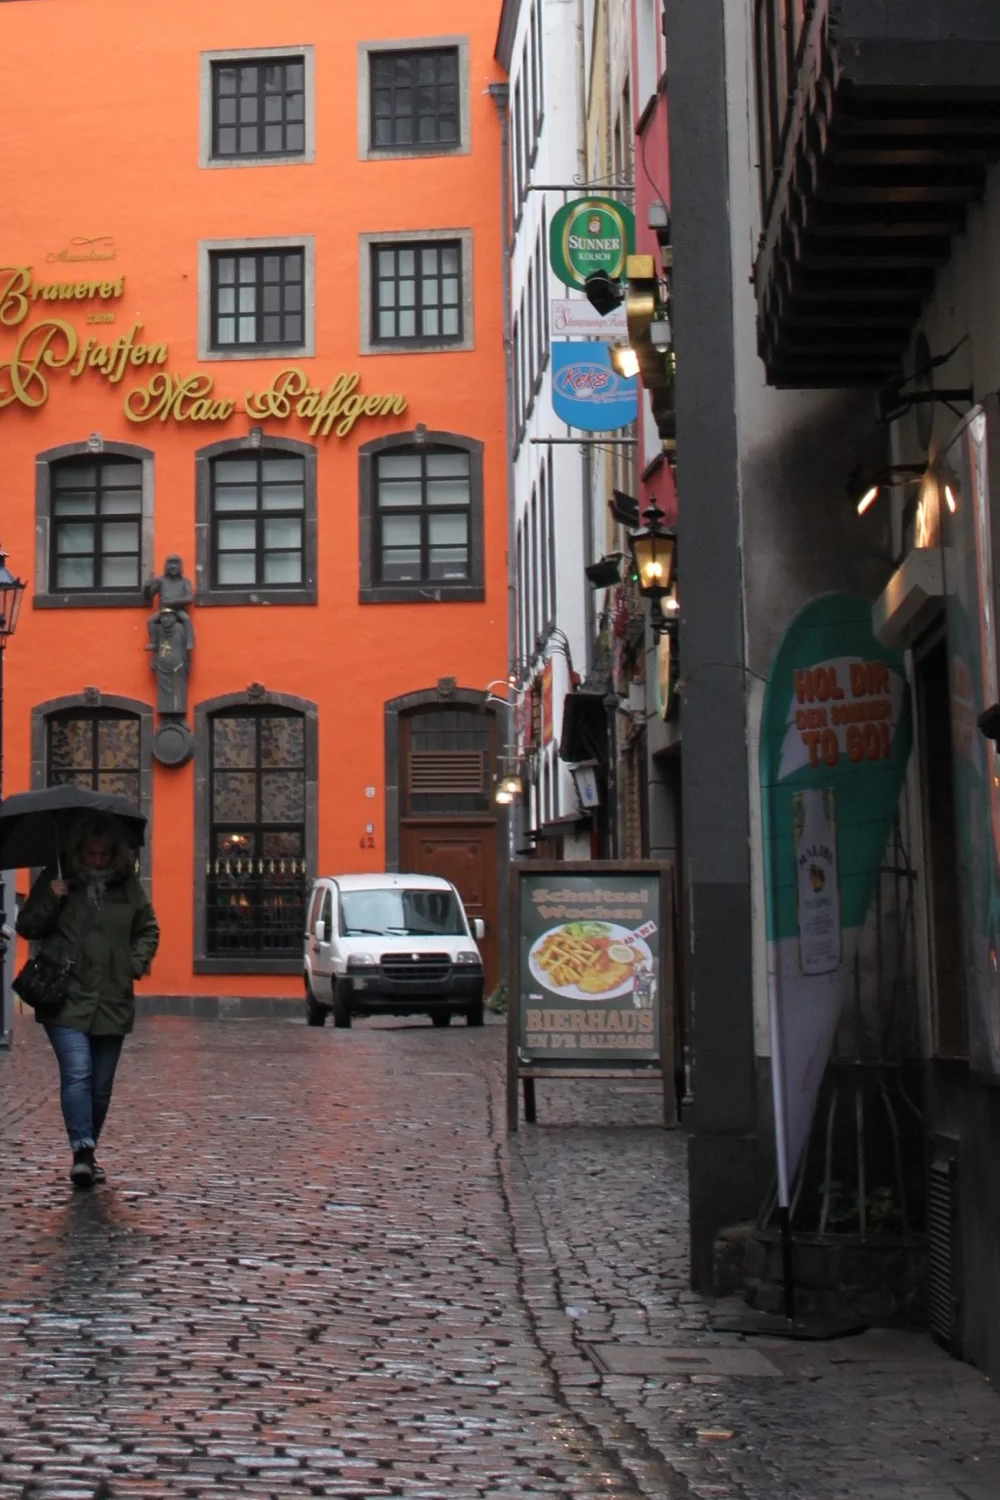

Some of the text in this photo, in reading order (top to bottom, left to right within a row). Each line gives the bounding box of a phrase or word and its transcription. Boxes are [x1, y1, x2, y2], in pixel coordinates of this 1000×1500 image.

[86, 311, 116, 325] zum
[563, 368, 609, 391] Keks
[124, 366, 408, 438] Max Päffgen
[794, 659, 891, 704] HOL DIR
[802, 722, 891, 768] TO GO!
[532, 889, 649, 904] Schnitzel
[537, 904, 643, 920] Wochen
[526, 1009, 654, 1033] BIERHAUS
[527, 1034, 547, 1049] EN
